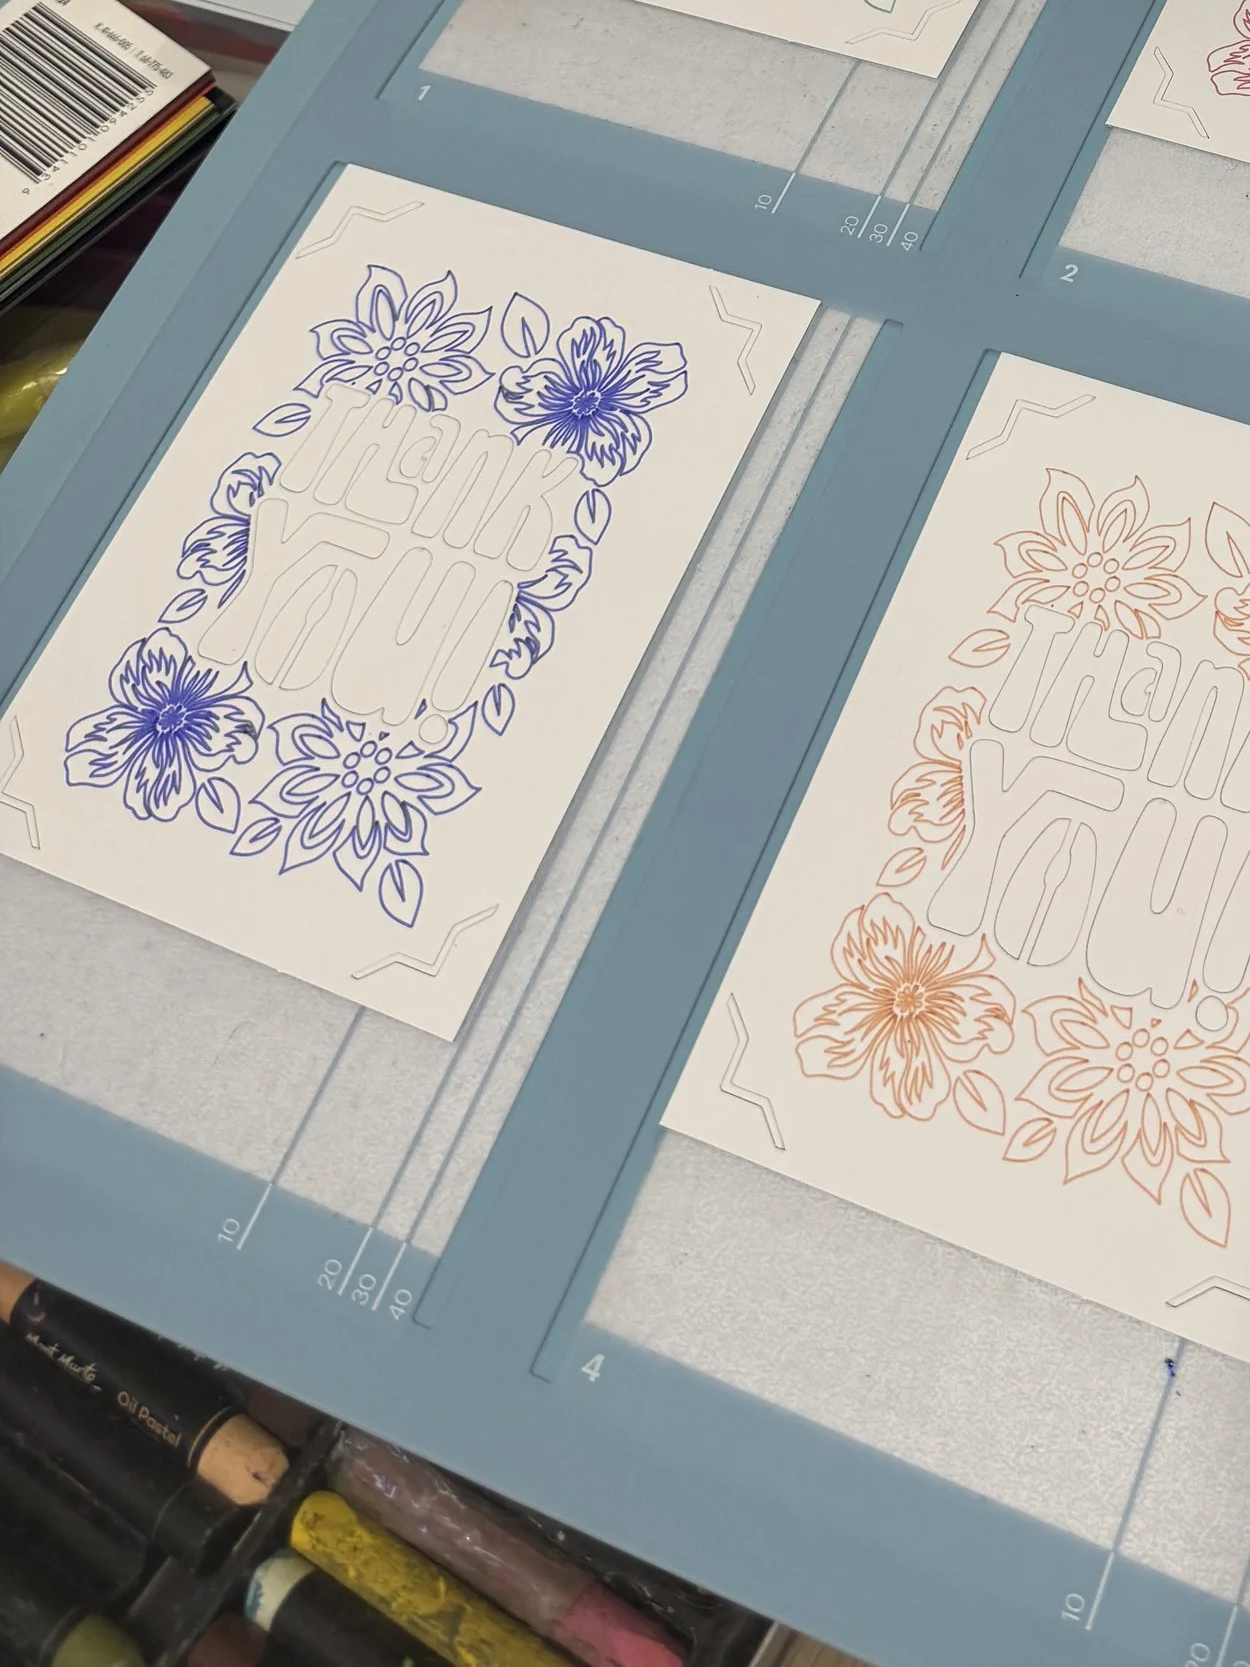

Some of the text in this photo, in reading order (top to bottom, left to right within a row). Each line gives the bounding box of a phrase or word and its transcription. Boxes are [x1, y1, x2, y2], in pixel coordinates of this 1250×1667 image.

[418, 84, 431, 101] 1
[754, 193, 773, 212] 10
[840, 214, 860, 236] 20
[869, 222, 889, 245] 30
[901, 230, 920, 252] 40
[1060, 264, 1080, 283] 2
[217, 1217, 241, 1243] 10
[316, 1258, 343, 1291] 20
[351, 1273, 377, 1306] 30
[389, 1289, 413, 1321] 40
[581, 1353, 605, 1383] 4
[117, 1390, 183, 1448] Oil Pastel
[1060, 1592, 1085, 1622] 10
